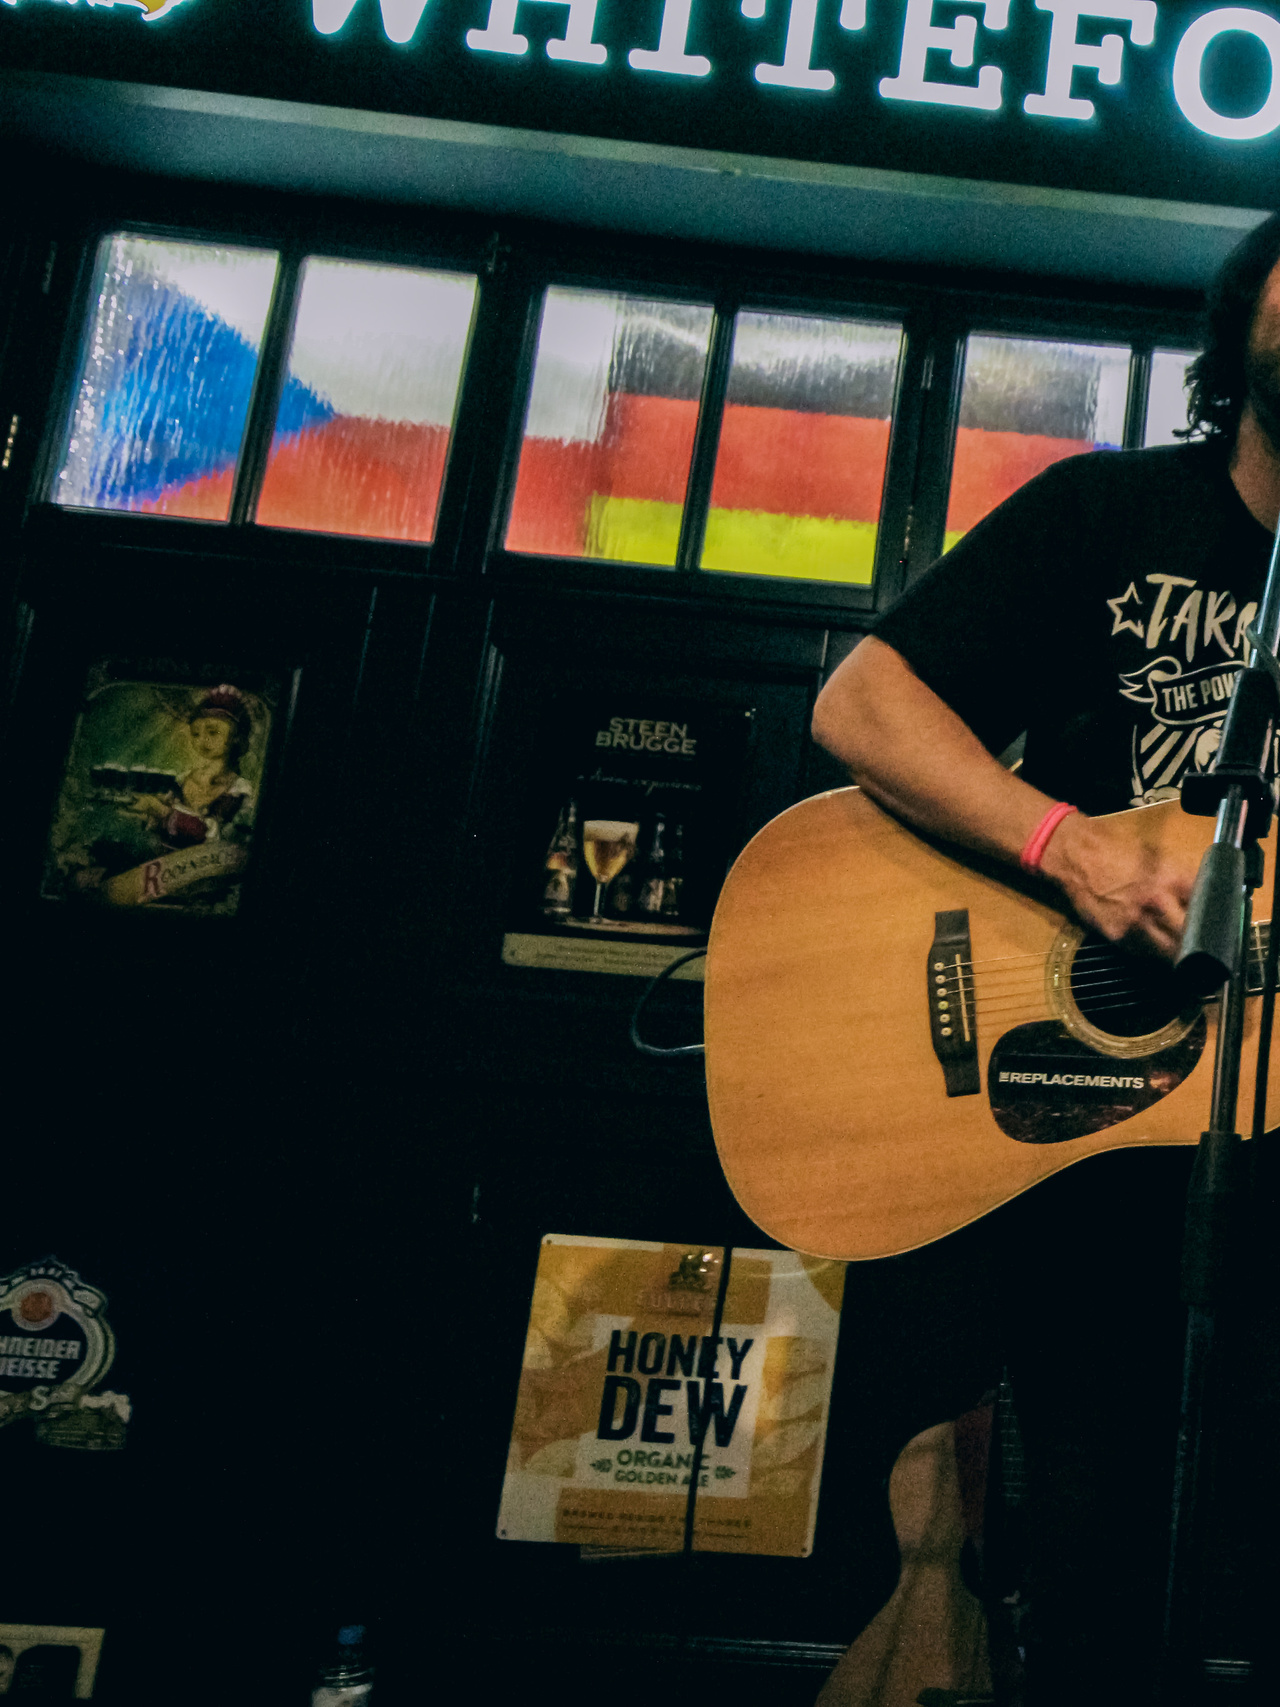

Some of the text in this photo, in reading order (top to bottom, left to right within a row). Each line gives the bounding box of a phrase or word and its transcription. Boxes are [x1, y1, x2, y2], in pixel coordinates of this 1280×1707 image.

[1161, 682, 1198, 713] THE
[1199, 672, 1235, 705] POW
[609, 716, 688, 739] STEEN
[595, 730, 698, 756] BRUGGE
[1010, 1072, 1146, 1089] REPLACEMENTS
[606, 1329, 754, 1380] HONEY
[597, 1375, 750, 1448] DEW
[617, 1449, 710, 1470] ORGANC
[615, 1470, 709, 1488] GOLDEN AE
